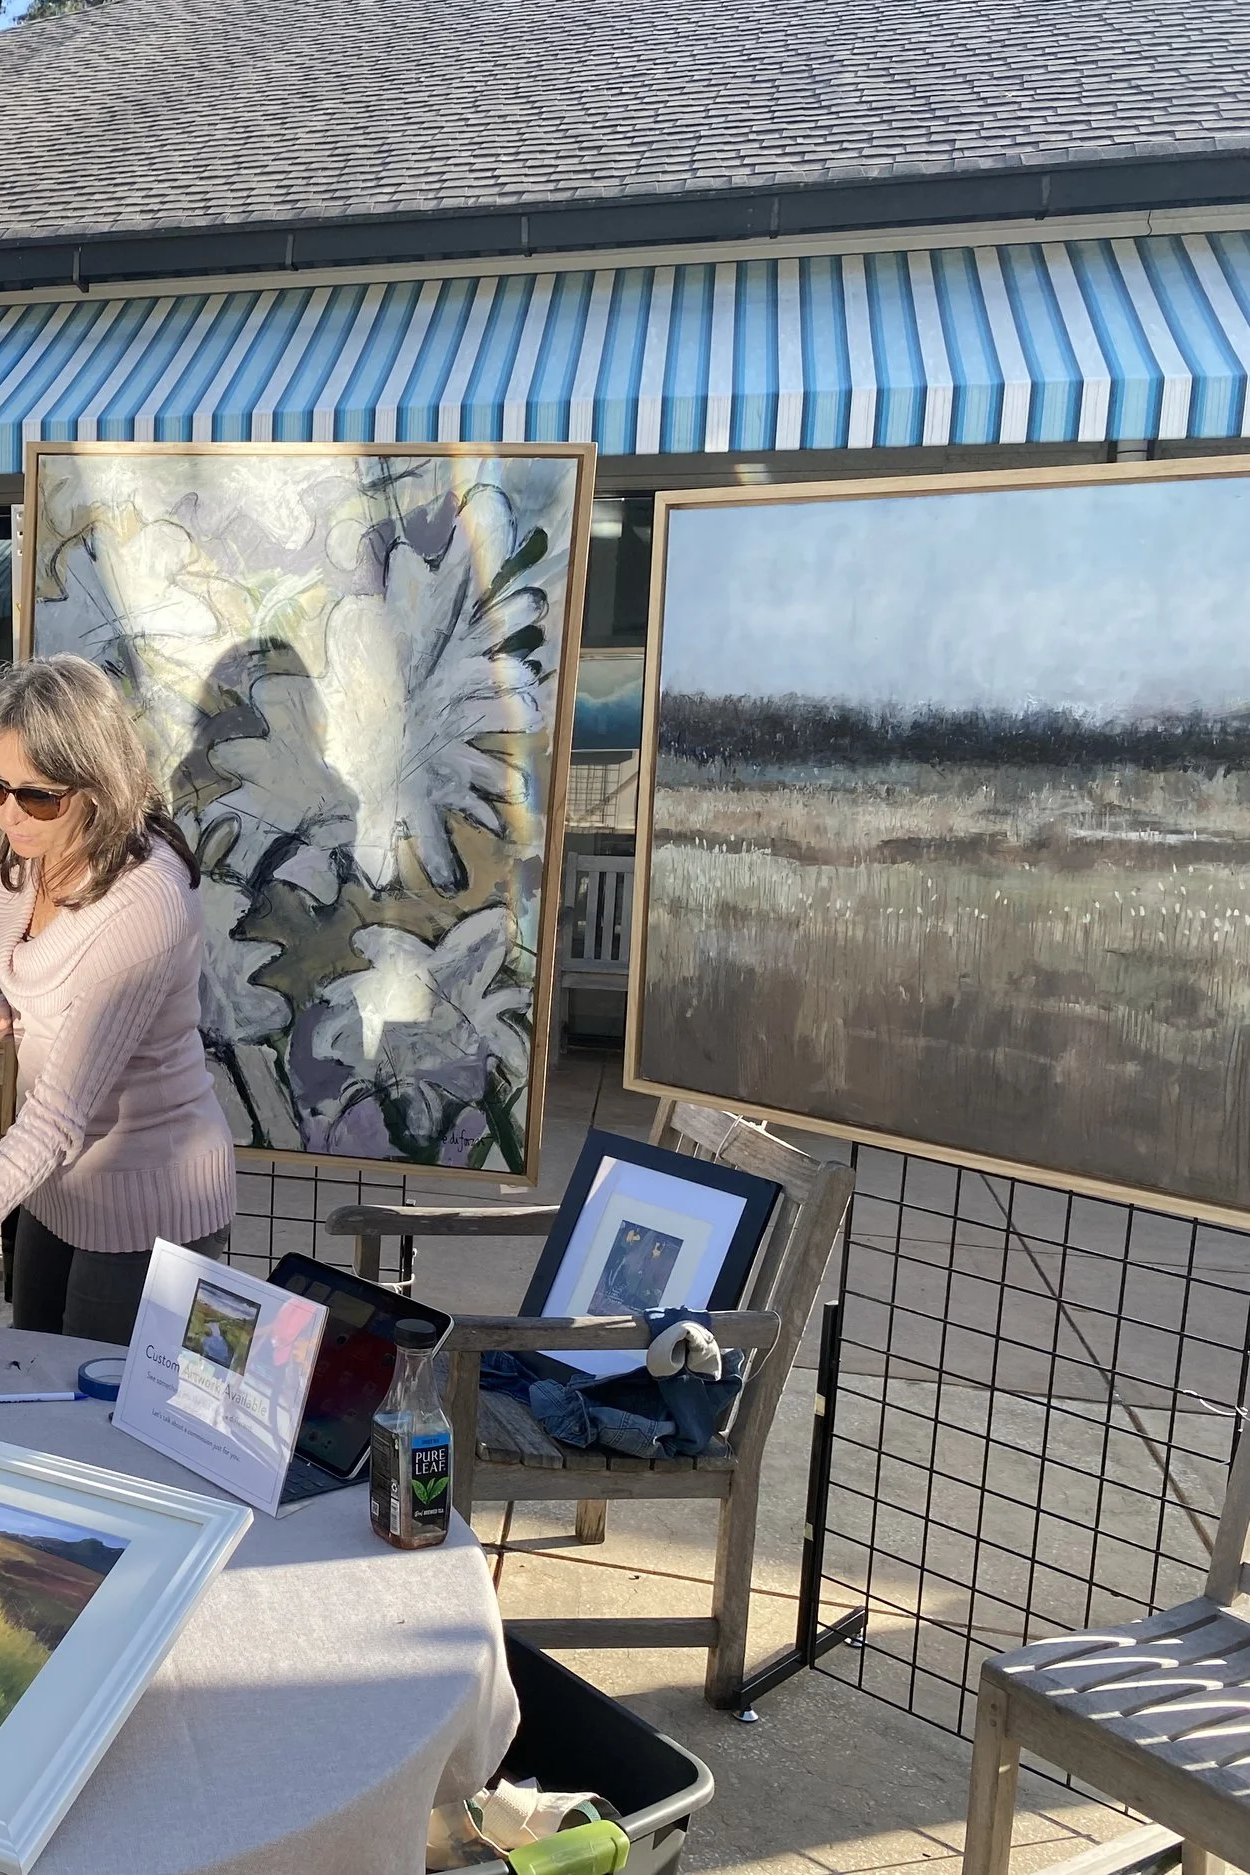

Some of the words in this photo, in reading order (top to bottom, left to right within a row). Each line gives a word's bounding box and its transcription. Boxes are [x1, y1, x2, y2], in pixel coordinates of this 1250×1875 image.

[145, 1344, 180, 1373] Custom
[182, 1362, 222, 1395] Artwork
[223, 1383, 267, 1417] Available
[415, 1448, 446, 1464] PURE
[415, 1460, 445, 1475] LEAF
